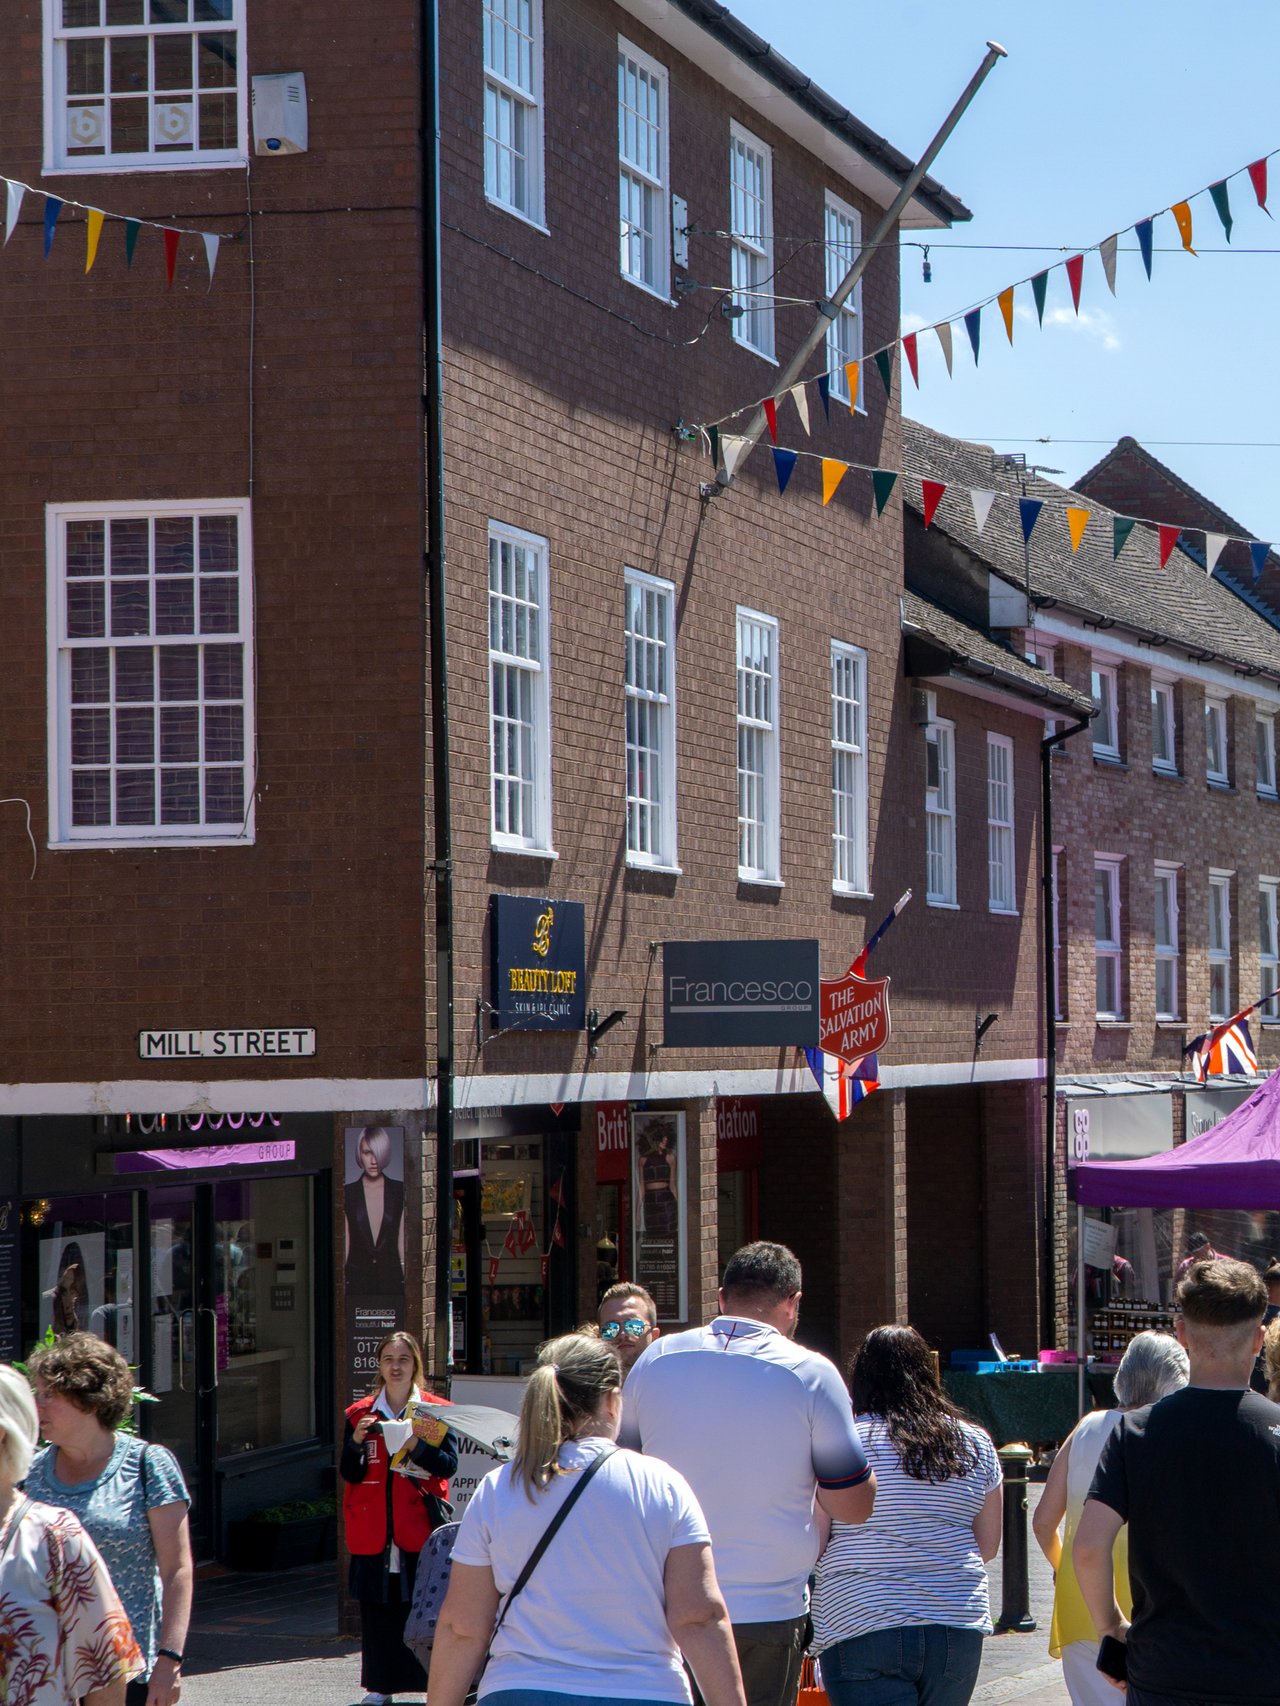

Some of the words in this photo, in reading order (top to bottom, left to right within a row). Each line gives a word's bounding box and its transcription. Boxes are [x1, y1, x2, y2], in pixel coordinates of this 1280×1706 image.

[510, 968, 549, 993] BEAUTY
[551, 970, 577, 994] LOFT
[669, 976, 812, 1001] Francesco
[829, 985, 855, 1010] THE
[515, 1002, 531, 1014] SKIN
[548, 1003, 571, 1016] CLINIC
[820, 992, 882, 1040] SALVATION
[147, 1033, 200, 1055] MILL
[213, 1031, 308, 1055] STREET
[839, 1018, 879, 1053] ARMY
[717, 1099, 757, 1139] dation
[597, 1109, 630, 1151] Briti
[258, 1144, 291, 1160] GROUP
[355, 1307, 396, 1316] Francesco
[381, 1320, 396, 1328] hair
[357, 1342, 379, 1353] 017
[457, 1437, 489, 1455] WA
[452, 1478, 481, 1488] APPL
[456, 1493, 472, 1502] 017
